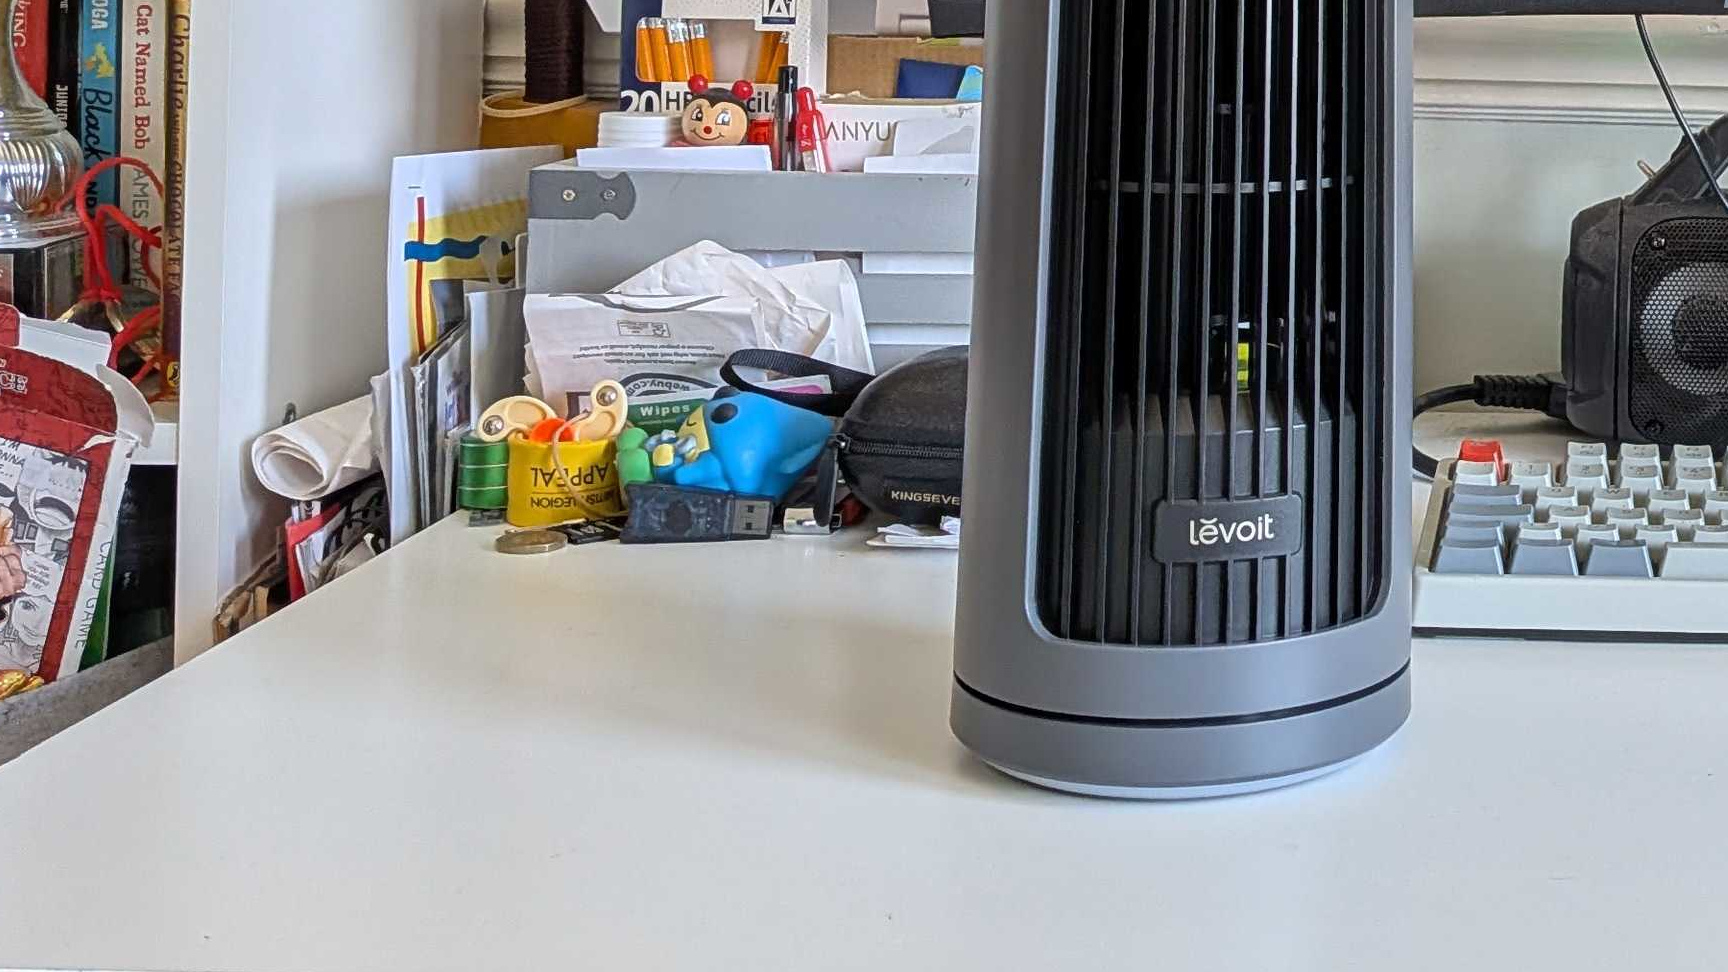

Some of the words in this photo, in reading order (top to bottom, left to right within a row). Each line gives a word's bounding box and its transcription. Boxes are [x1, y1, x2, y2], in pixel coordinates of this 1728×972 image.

[135, 4, 153, 36] Cat
[133, 42, 152, 107] Named
[621, 89, 662, 112] 20
[83, 87, 113, 163] Black
[133, 114, 151, 150] Bob
[131, 166, 150, 220] AMES
[626, 378, 691, 398] webuy.com
[639, 402, 691, 417] Wipes
[531, 461, 610, 487] APPEAL
[531, 496, 577, 509] LEGION
